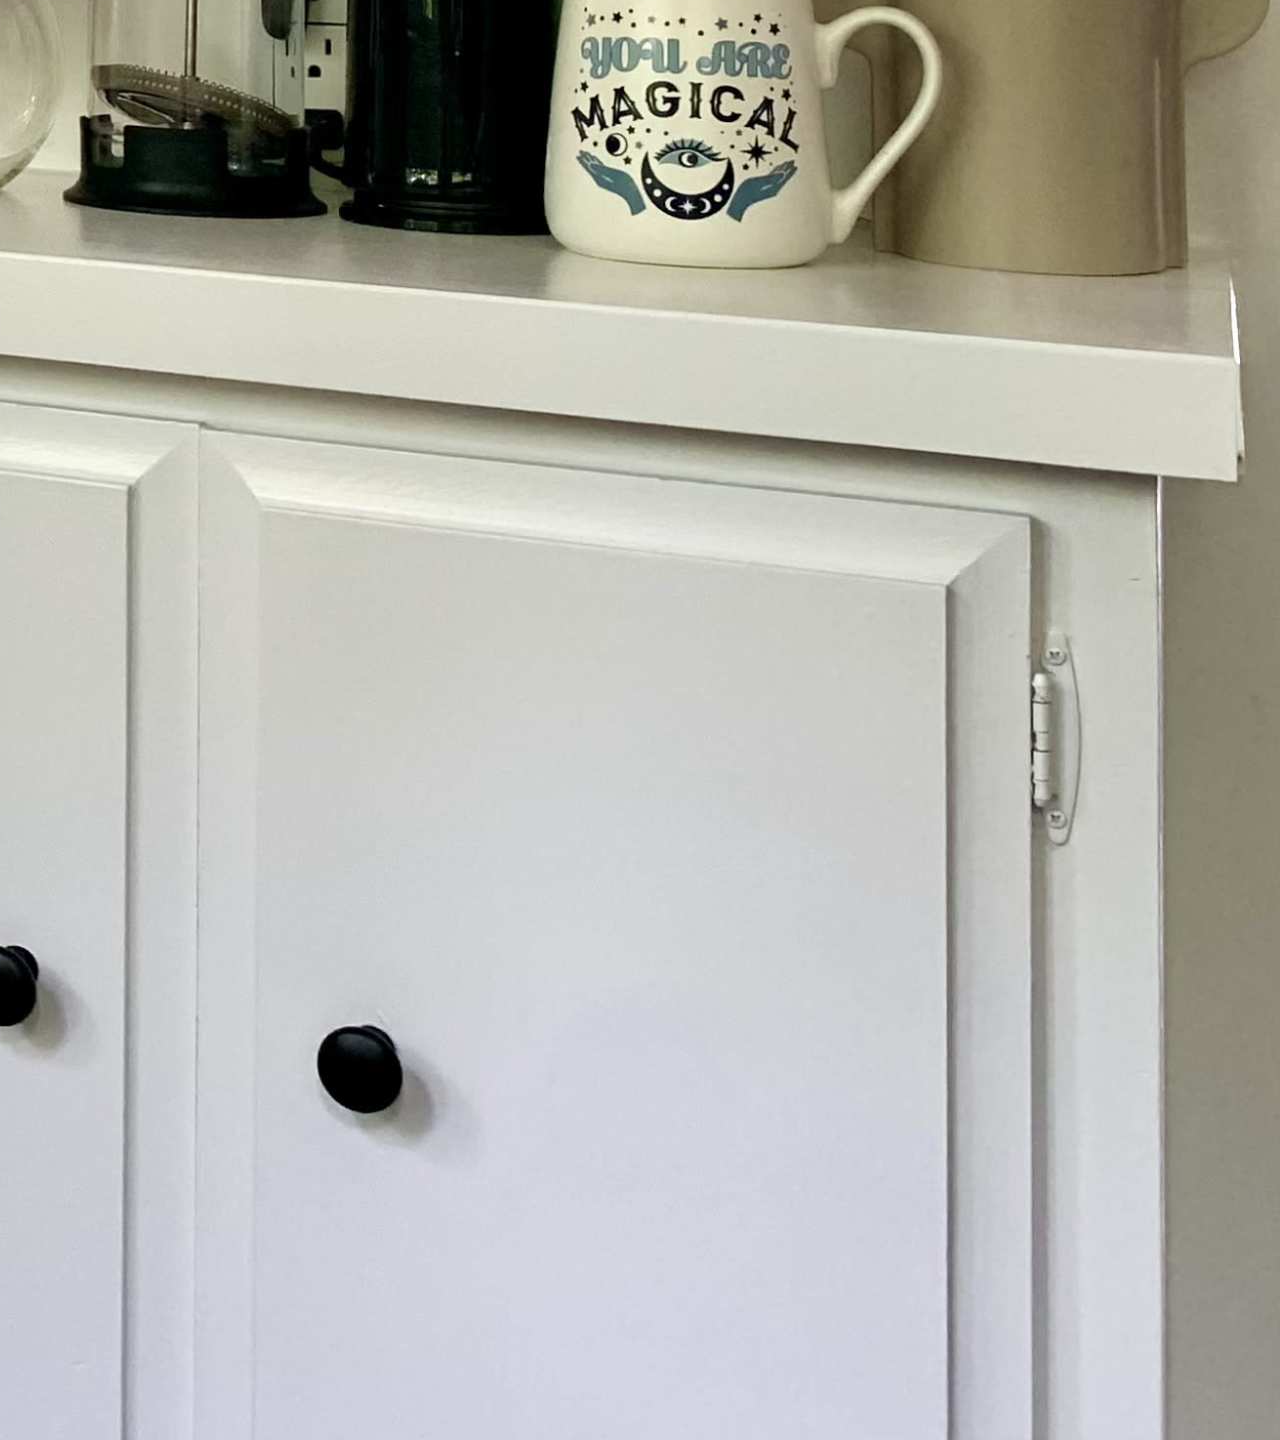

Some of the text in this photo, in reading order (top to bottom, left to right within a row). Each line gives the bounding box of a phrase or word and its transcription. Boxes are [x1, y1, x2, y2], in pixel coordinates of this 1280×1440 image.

[581, 36, 792, 80] YOU ARE
[571, 80, 800, 153] MAGICAL
